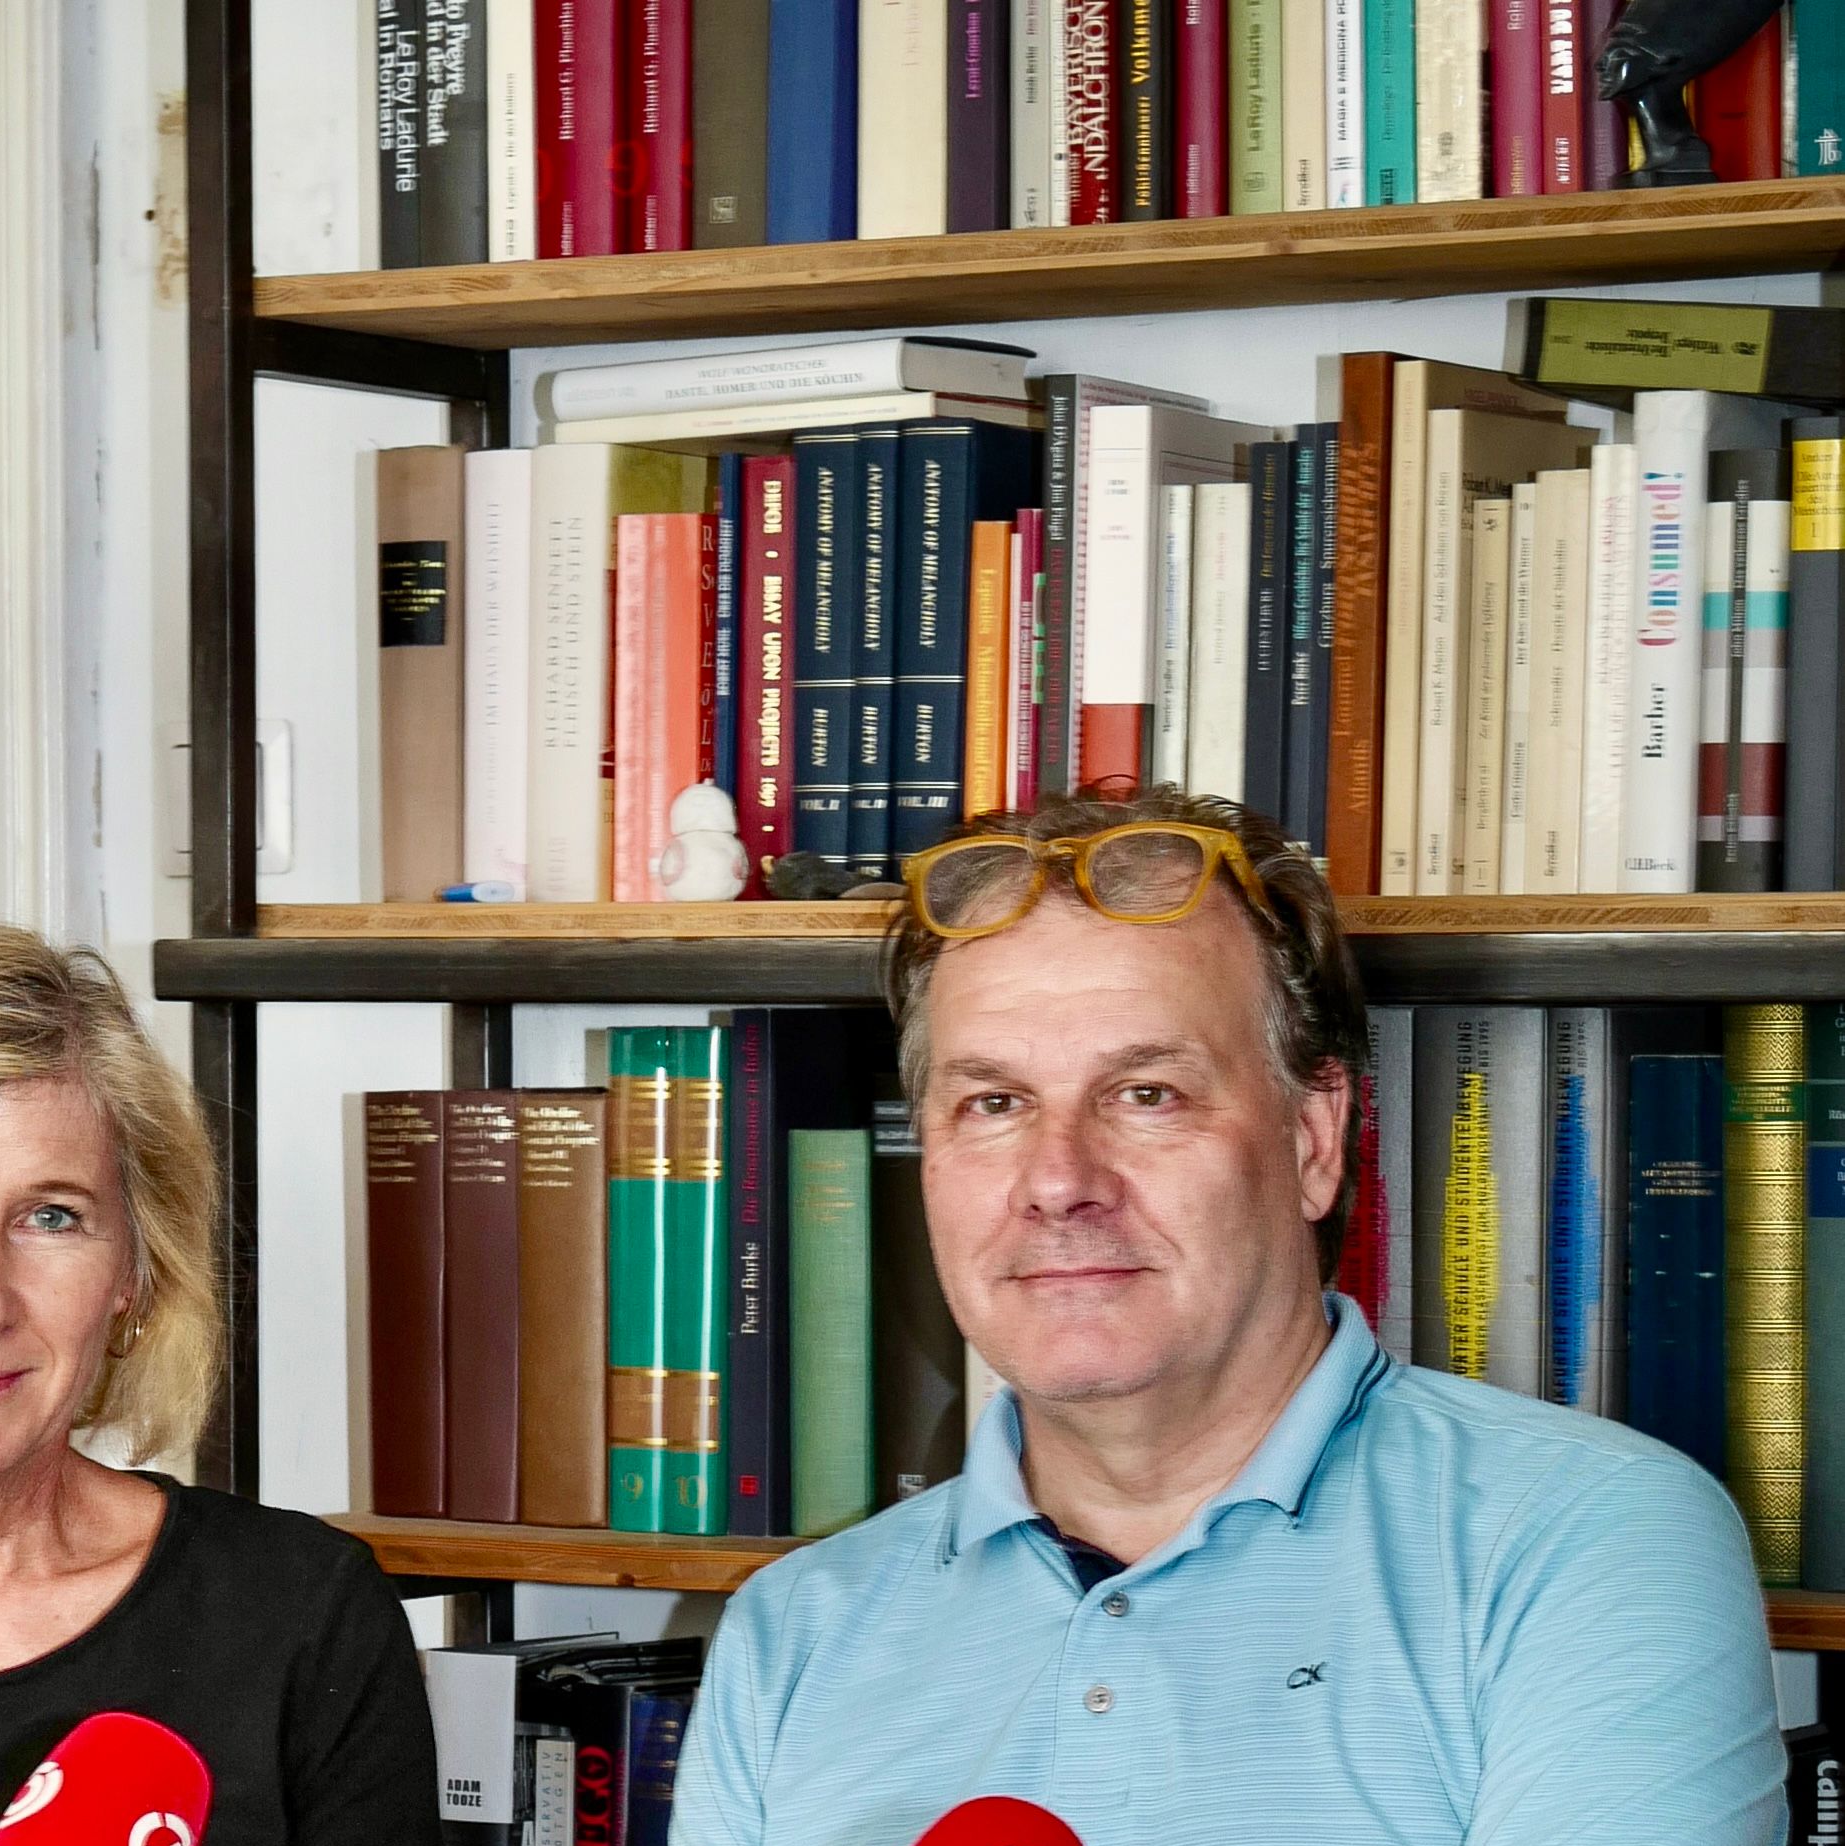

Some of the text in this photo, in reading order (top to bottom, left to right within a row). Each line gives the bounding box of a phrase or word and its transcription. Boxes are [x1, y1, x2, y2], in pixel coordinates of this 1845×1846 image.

[426, 47, 447, 83] der
[443, 23, 471, 95] Freyre
[379, 53, 397, 150] Romans
[392, 31, 420, 191] Le Roy Ladurie
[426, 89, 449, 146] Stadt
[815, 467, 834, 651] ANATOMY OF MELANCHOLY
[864, 463, 883, 649] ANATOMY OF MELANCHOLY
[919, 459, 941, 646] ANATOMY OF MELANCHOLY
[1316, 442, 1338, 650] Ginzburg Spurensicherungen
[544, 518, 562, 748] RICHARD SENNETT
[565, 517, 582, 748] FLEISCH UND STEIN
[1636, 472, 1683, 759] Barber Consumed!
[762, 632, 782, 680] UPON
[1291, 653, 1311, 681] Burke
[1290, 683, 1309, 707] Peter
[758, 688, 780, 766] PROJECTS
[811, 706, 829, 764] BURTON
[861, 705, 878, 762] BURTON
[914, 702, 934, 761] BURTON
[1454, 1021, 1472, 1206] STUDENTENBEWEGUNG
[1555, 1021, 1571, 1207] STUDENTENBEWEGUNG
[1454, 1215, 1469, 1246] UND
[1554, 1215, 1569, 1248] UND
[741, 1242, 759, 1289] Burke
[1453, 1255, 1469, 1316] SCHULE
[740, 1295, 760, 1334] Peter
[446, 1793, 482, 1807] TOOZE
[447, 1778, 481, 1793] ADAM
[552, 1752, 564, 1830] TAGEN
